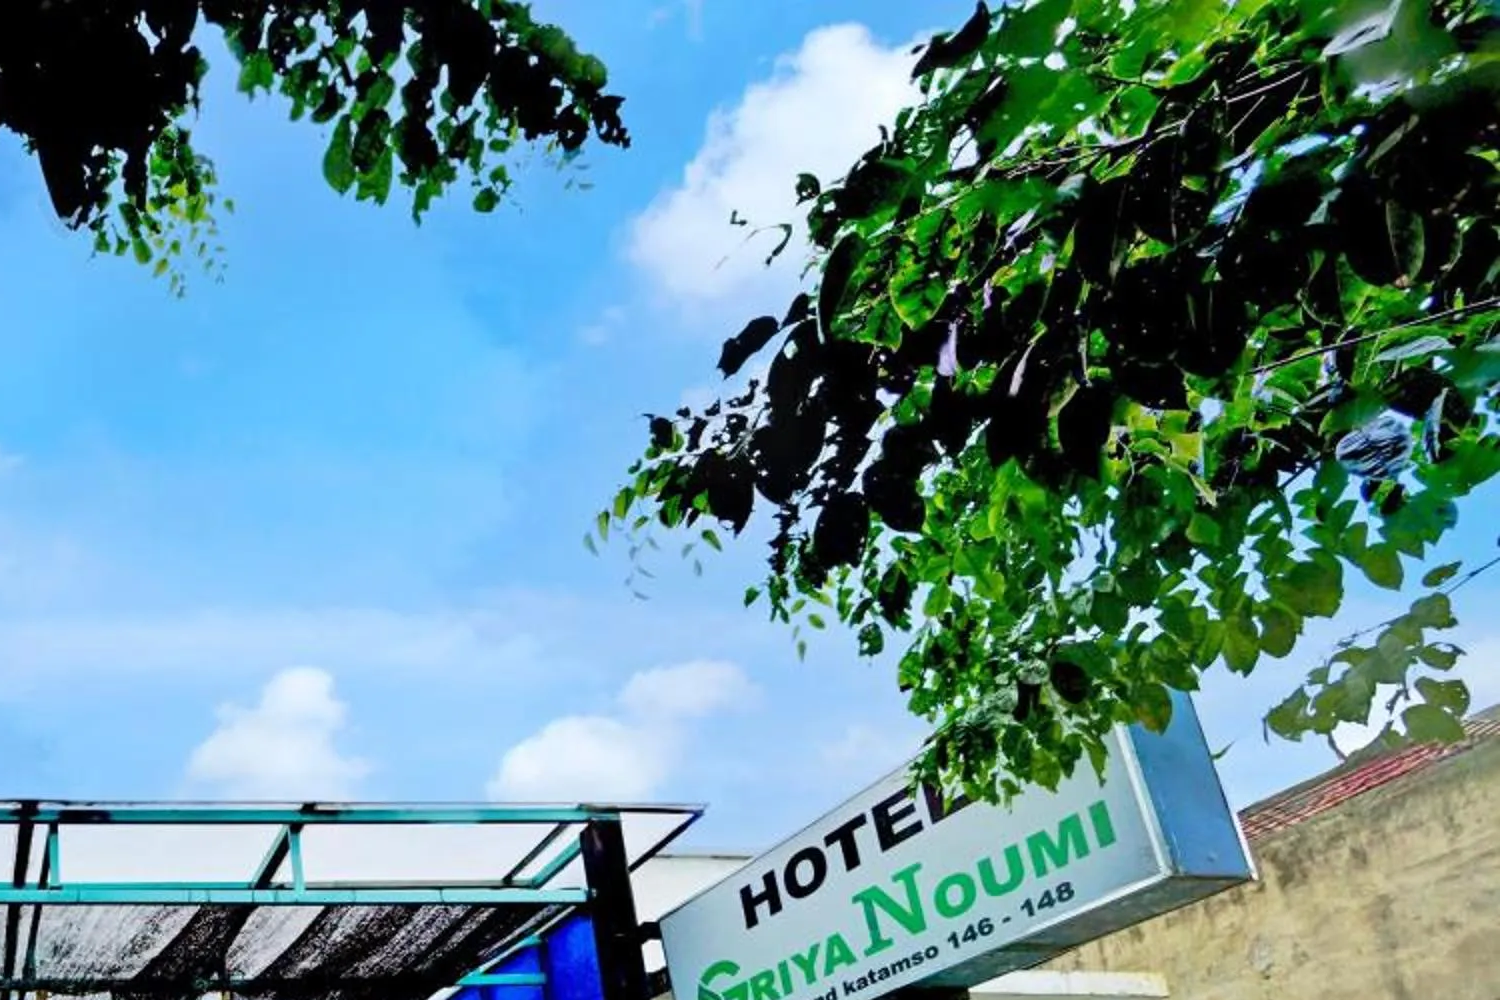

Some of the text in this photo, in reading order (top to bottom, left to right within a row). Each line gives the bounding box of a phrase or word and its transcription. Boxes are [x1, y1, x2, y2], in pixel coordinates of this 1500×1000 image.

[842, 945, 939, 997] katamso
[947, 917, 995, 950] 146
[1020, 881, 1076, 918] 148
[852, 800, 1116, 957] NOUMI
